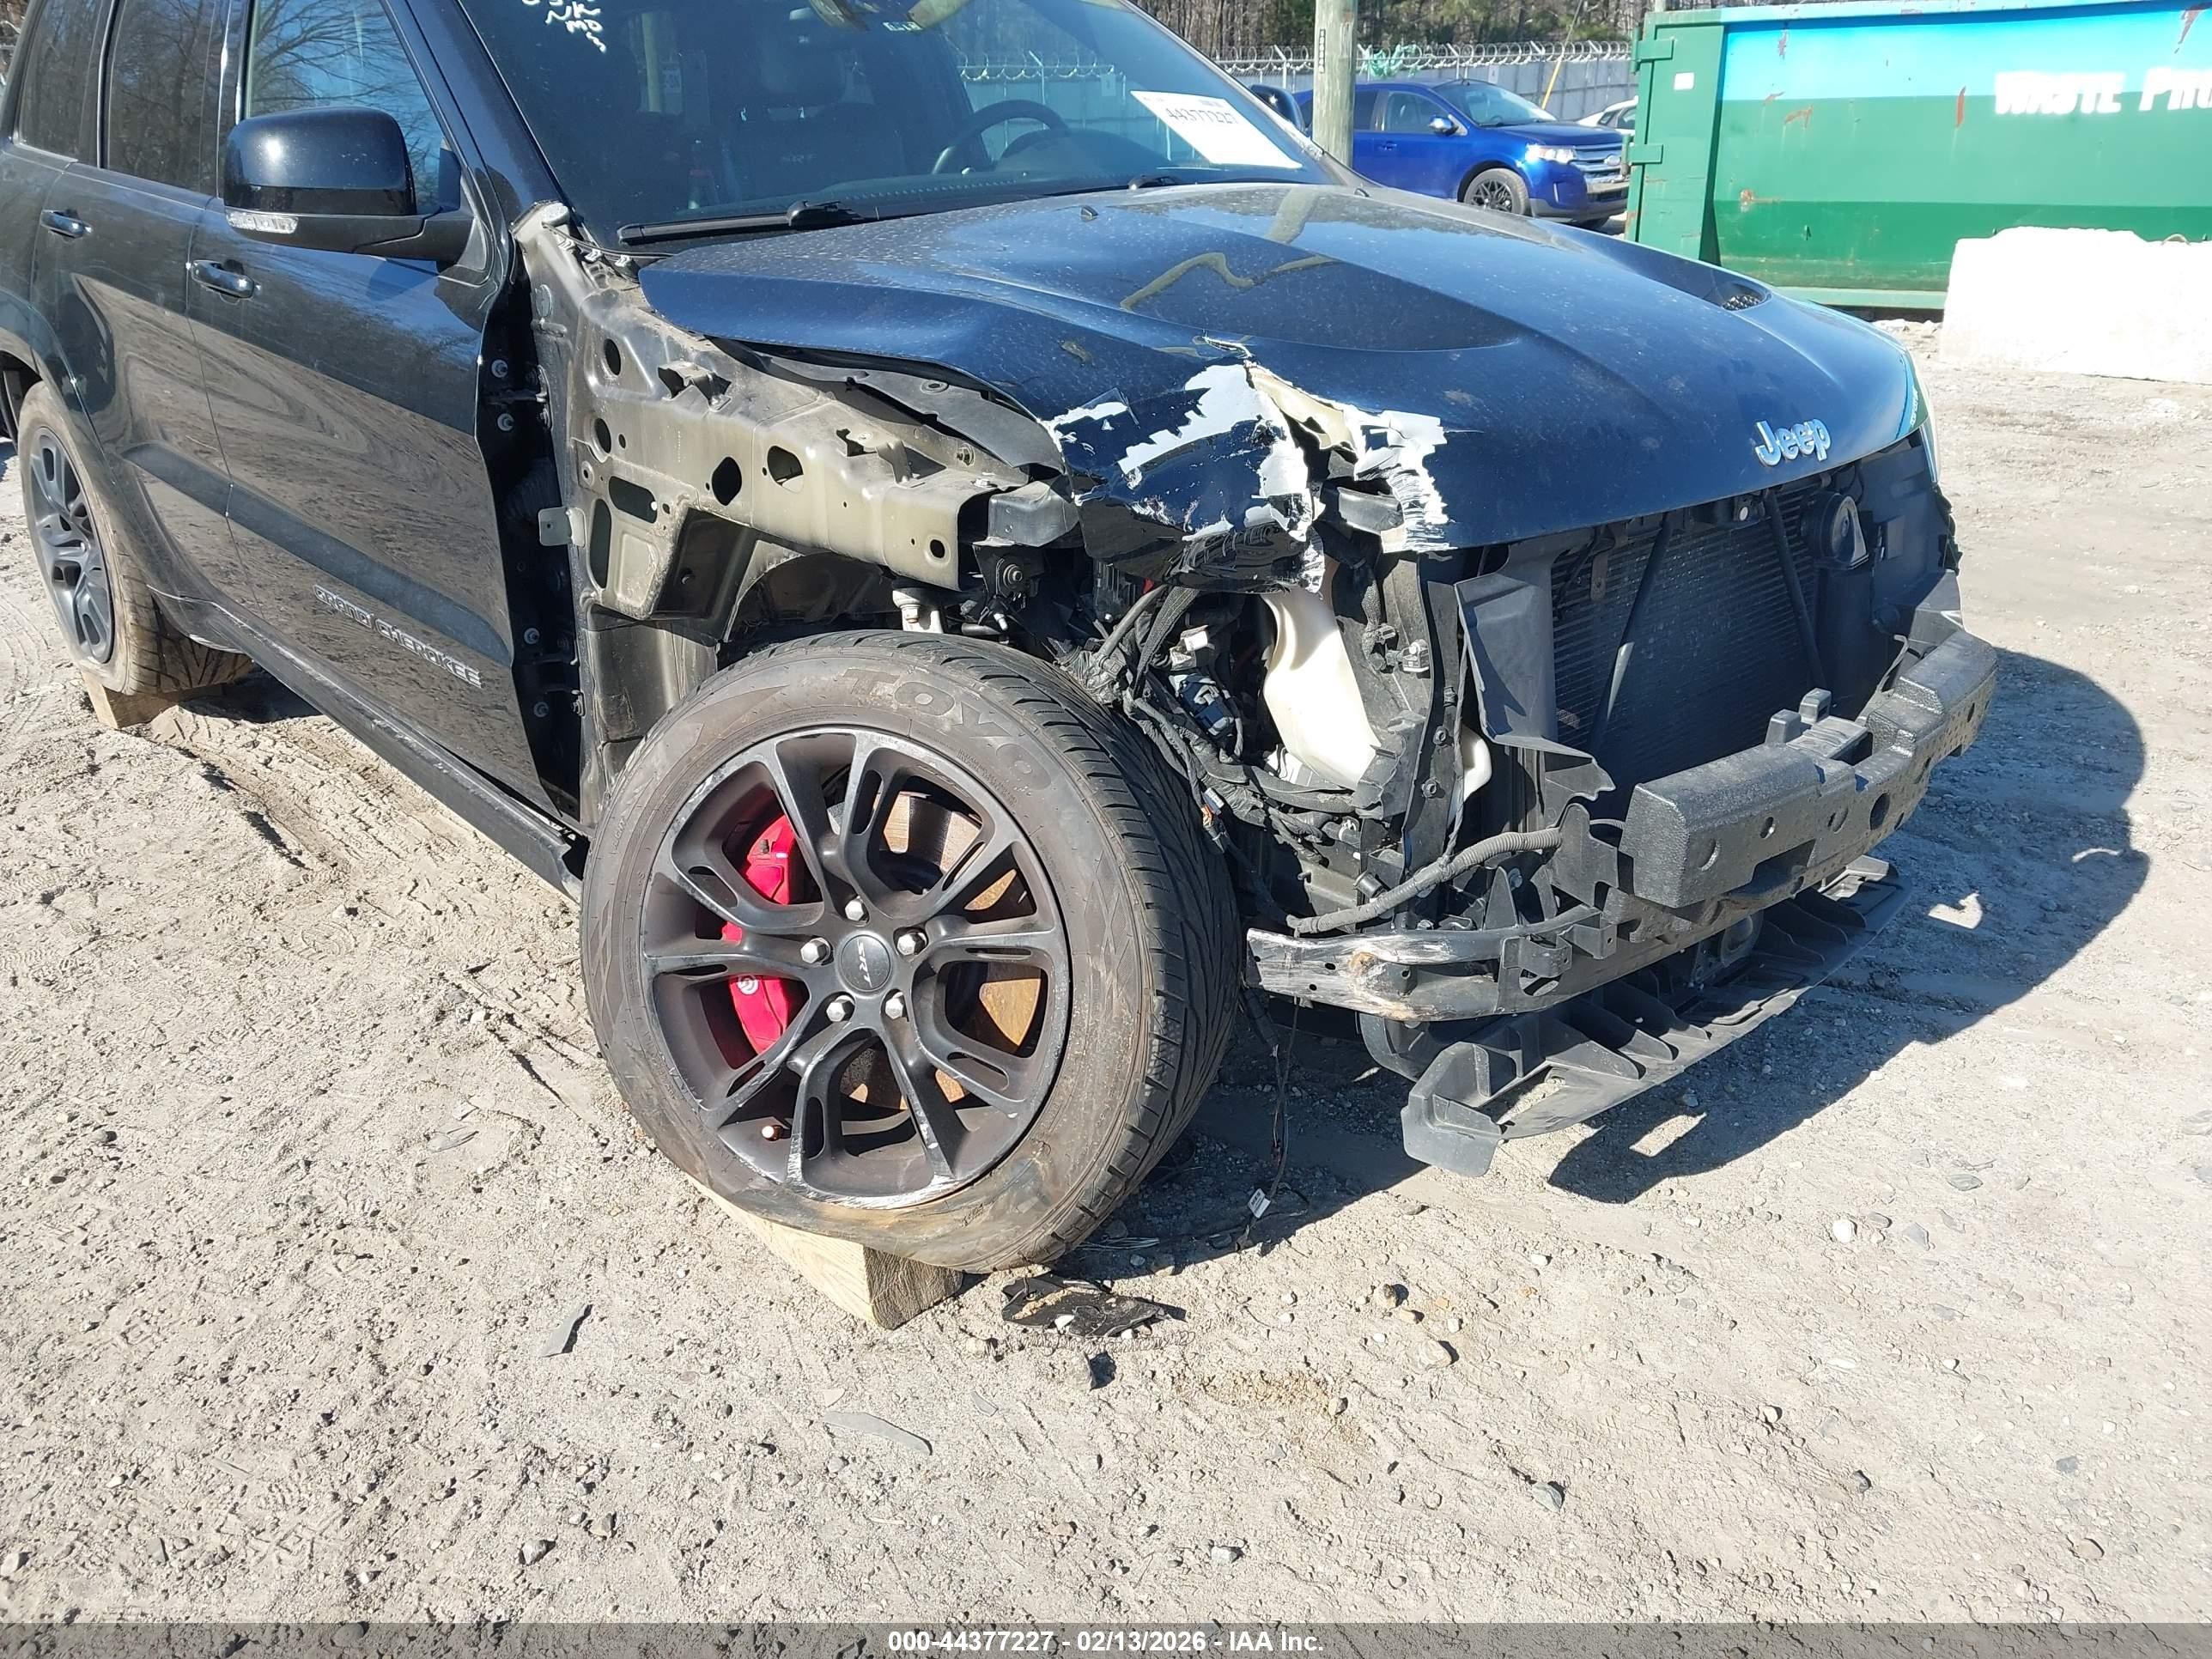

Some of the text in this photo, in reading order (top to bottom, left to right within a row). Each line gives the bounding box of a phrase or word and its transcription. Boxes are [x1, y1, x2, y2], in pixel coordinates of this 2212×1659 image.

[1165, 107, 1238, 125] 44377227
[1994, 70, 2127, 115] WASTE
[1754, 418, 1831, 466] Jeep
[313, 584, 483, 689] GRAND CHEROKEE
[842, 667, 1053, 792] TOYO
[856, 939, 873, 988] SRT
